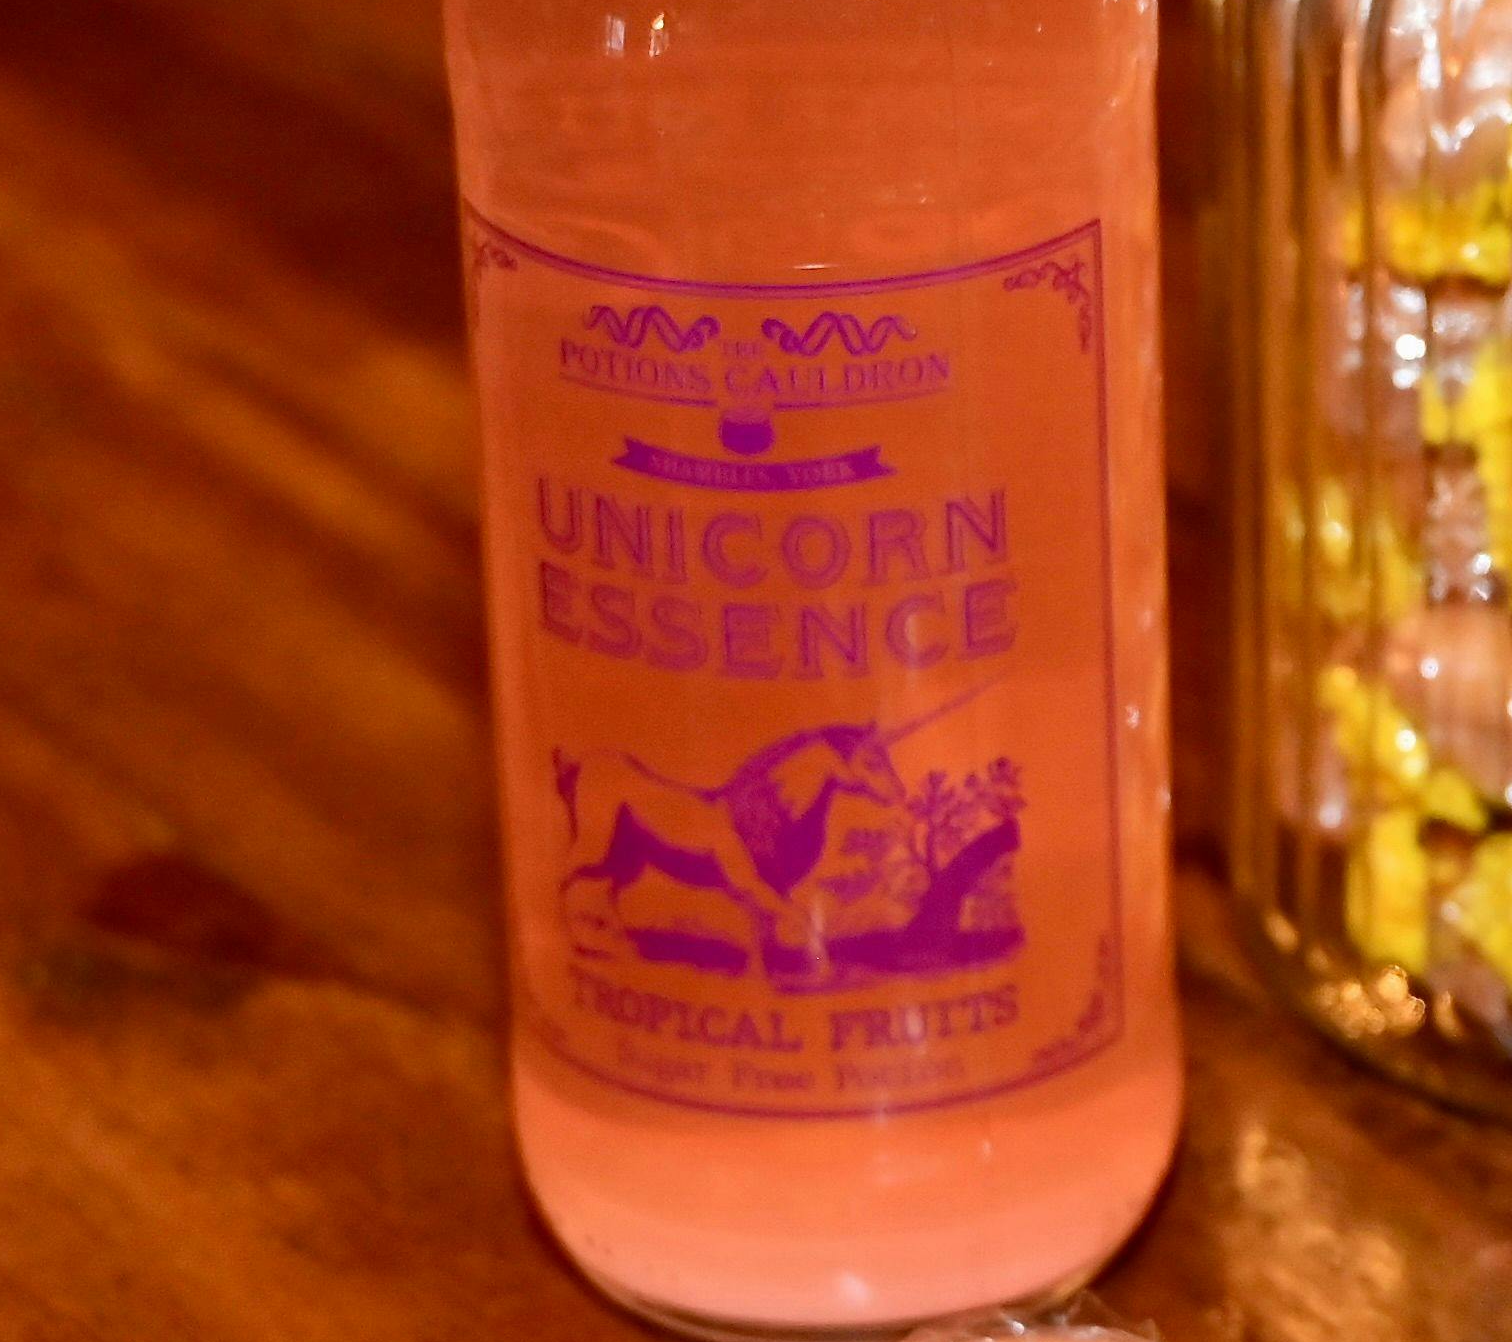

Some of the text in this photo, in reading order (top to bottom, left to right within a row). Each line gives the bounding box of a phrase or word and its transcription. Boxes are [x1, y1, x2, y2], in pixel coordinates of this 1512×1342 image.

[559, 338, 952, 396] POTIONS CAULDRON
[535, 477, 1009, 591] UNICORN
[537, 560, 1019, 681] ESSENCE
[568, 962, 1021, 1054] TROPICAL FRUITS
